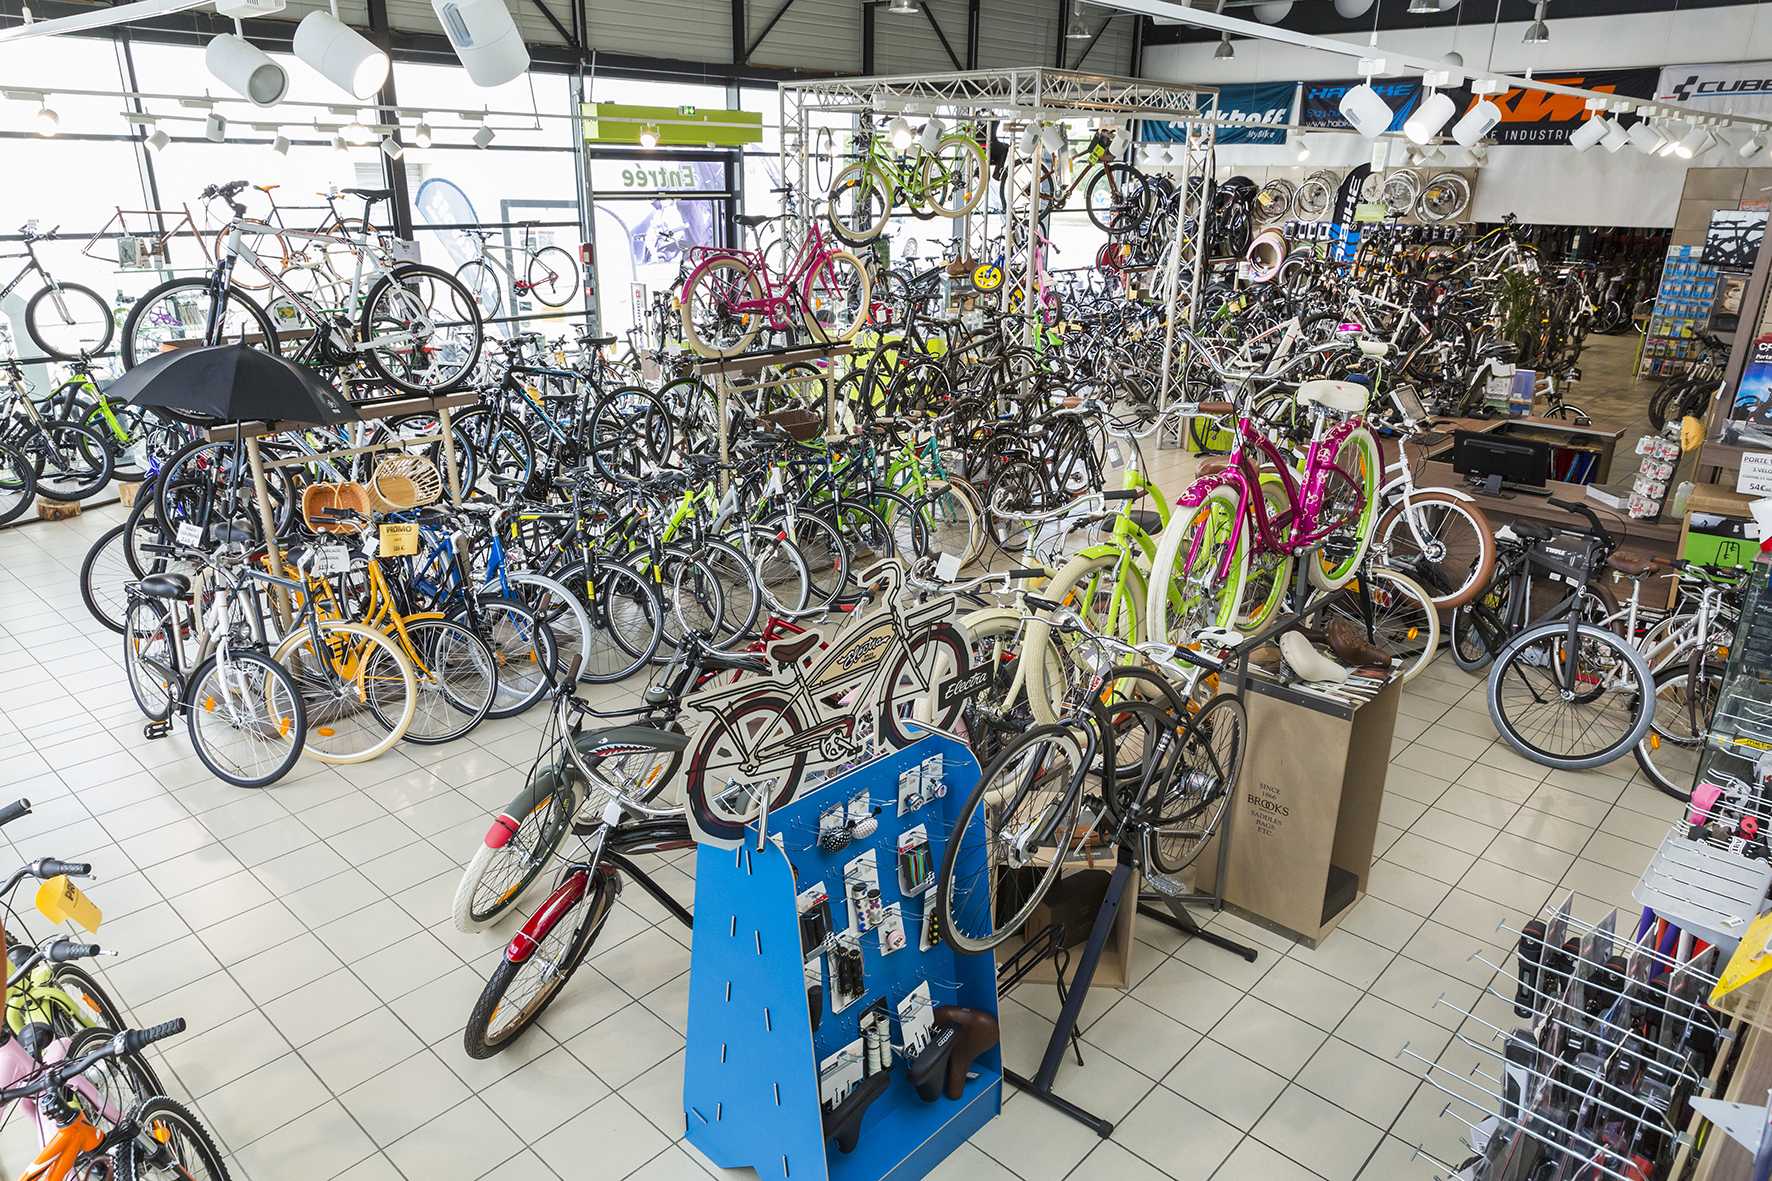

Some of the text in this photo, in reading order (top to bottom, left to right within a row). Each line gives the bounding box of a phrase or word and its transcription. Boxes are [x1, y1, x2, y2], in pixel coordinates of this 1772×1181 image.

[1309, 84, 1415, 99] HAIKE
[1462, 77, 1616, 122] KTM
[1306, 108, 1326, 118] Stay
[1246, 130, 1275, 139] MyBike
[1744, 456, 1768, 465] PORTE
[386, 526, 412, 534] PROMO
[1545, 546, 1567, 556] THULE
[837, 635, 891, 670] Electra
[945, 672, 988, 700] Electra
[1259, 783, 1281, 795] SINCE
[1262, 791, 1277, 800] 1866
[1247, 794, 1290, 817] BROOKS
[1250, 810, 1282, 826] SADDLES
[1256, 819, 1275, 830] BAGS
[1257, 826, 1273, 837] ETC.
